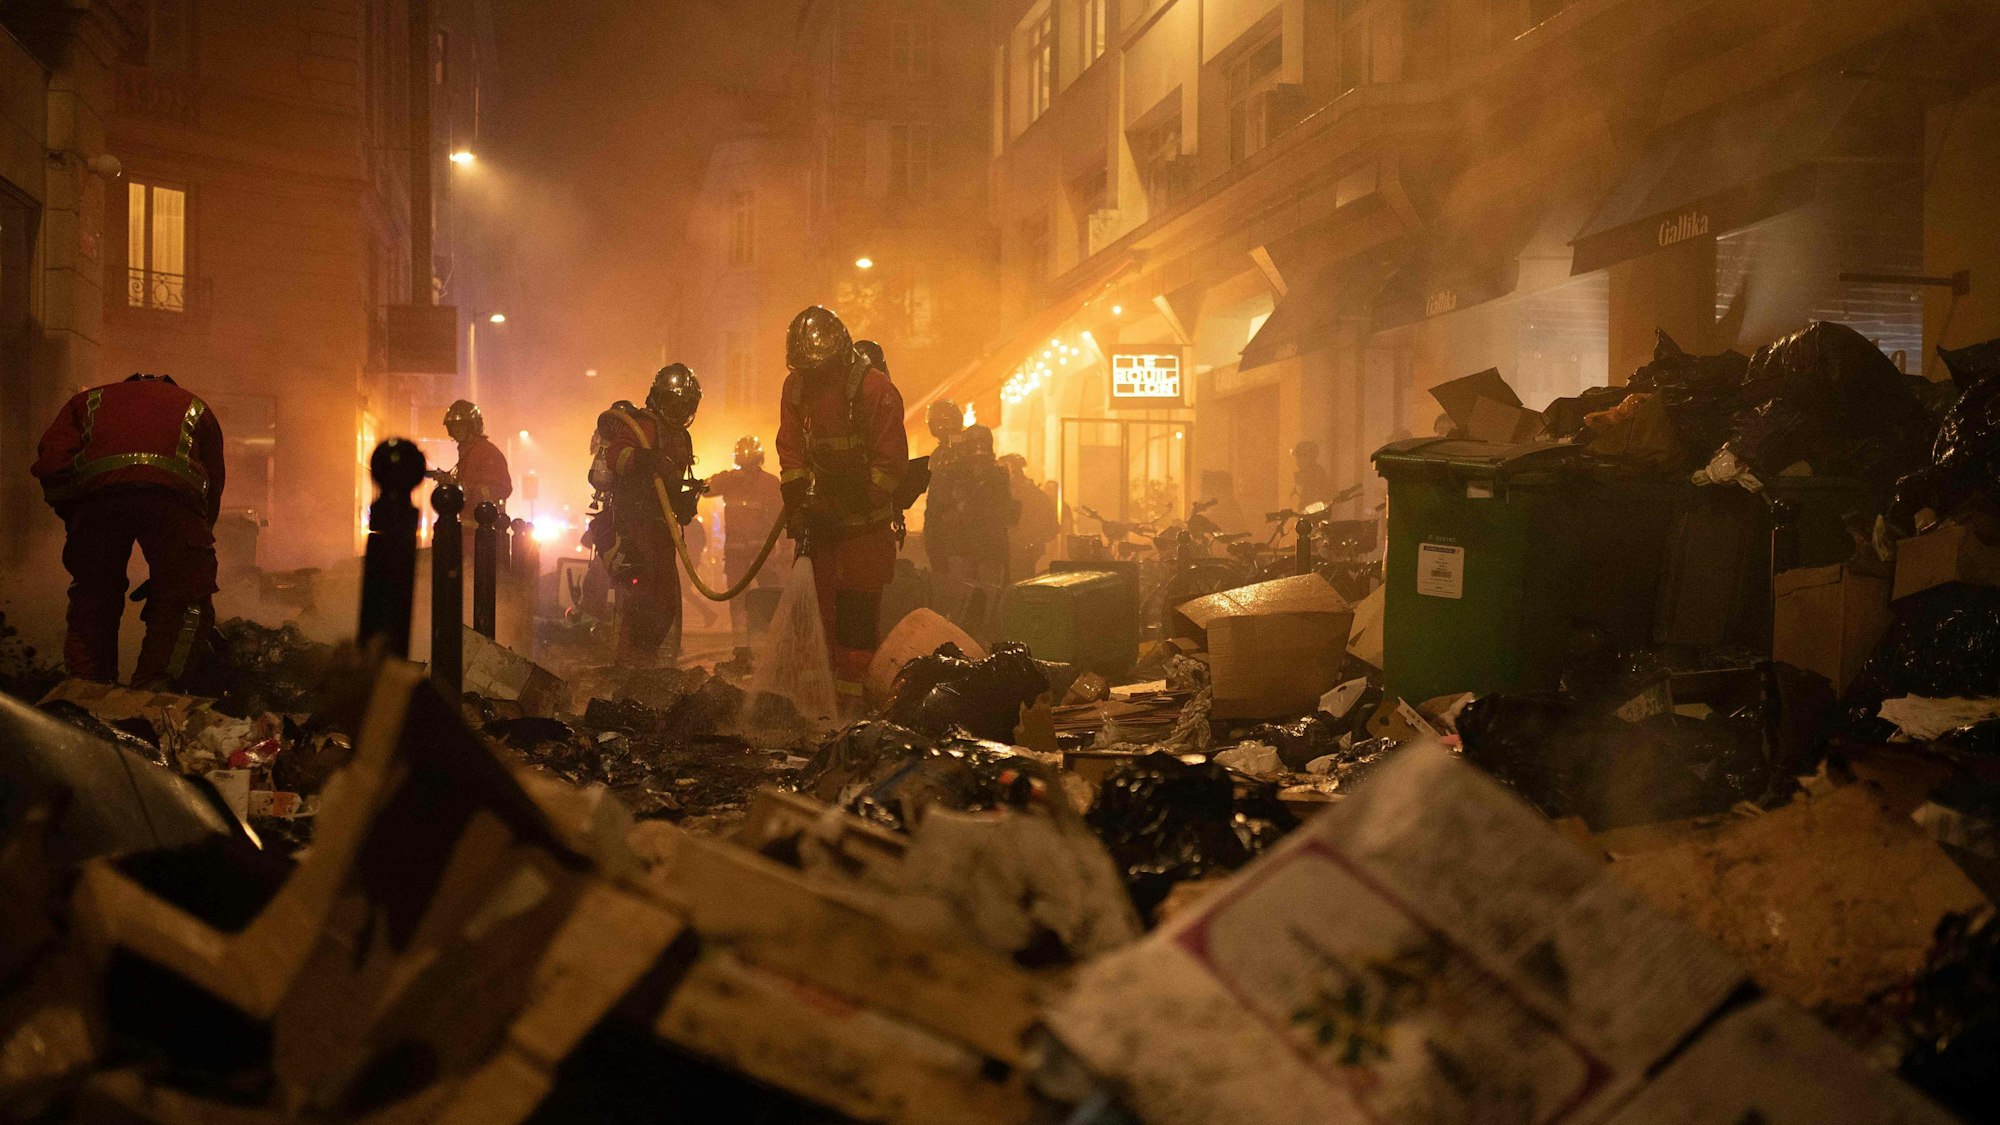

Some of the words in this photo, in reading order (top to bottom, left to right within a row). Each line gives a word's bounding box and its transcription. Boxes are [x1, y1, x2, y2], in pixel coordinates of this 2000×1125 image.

[1659, 211, 1708, 247] Gallika
[1426, 291, 1457, 317] Gallika
[1132, 355, 1156, 369] LE
[1134, 383, 1174, 396] LON
